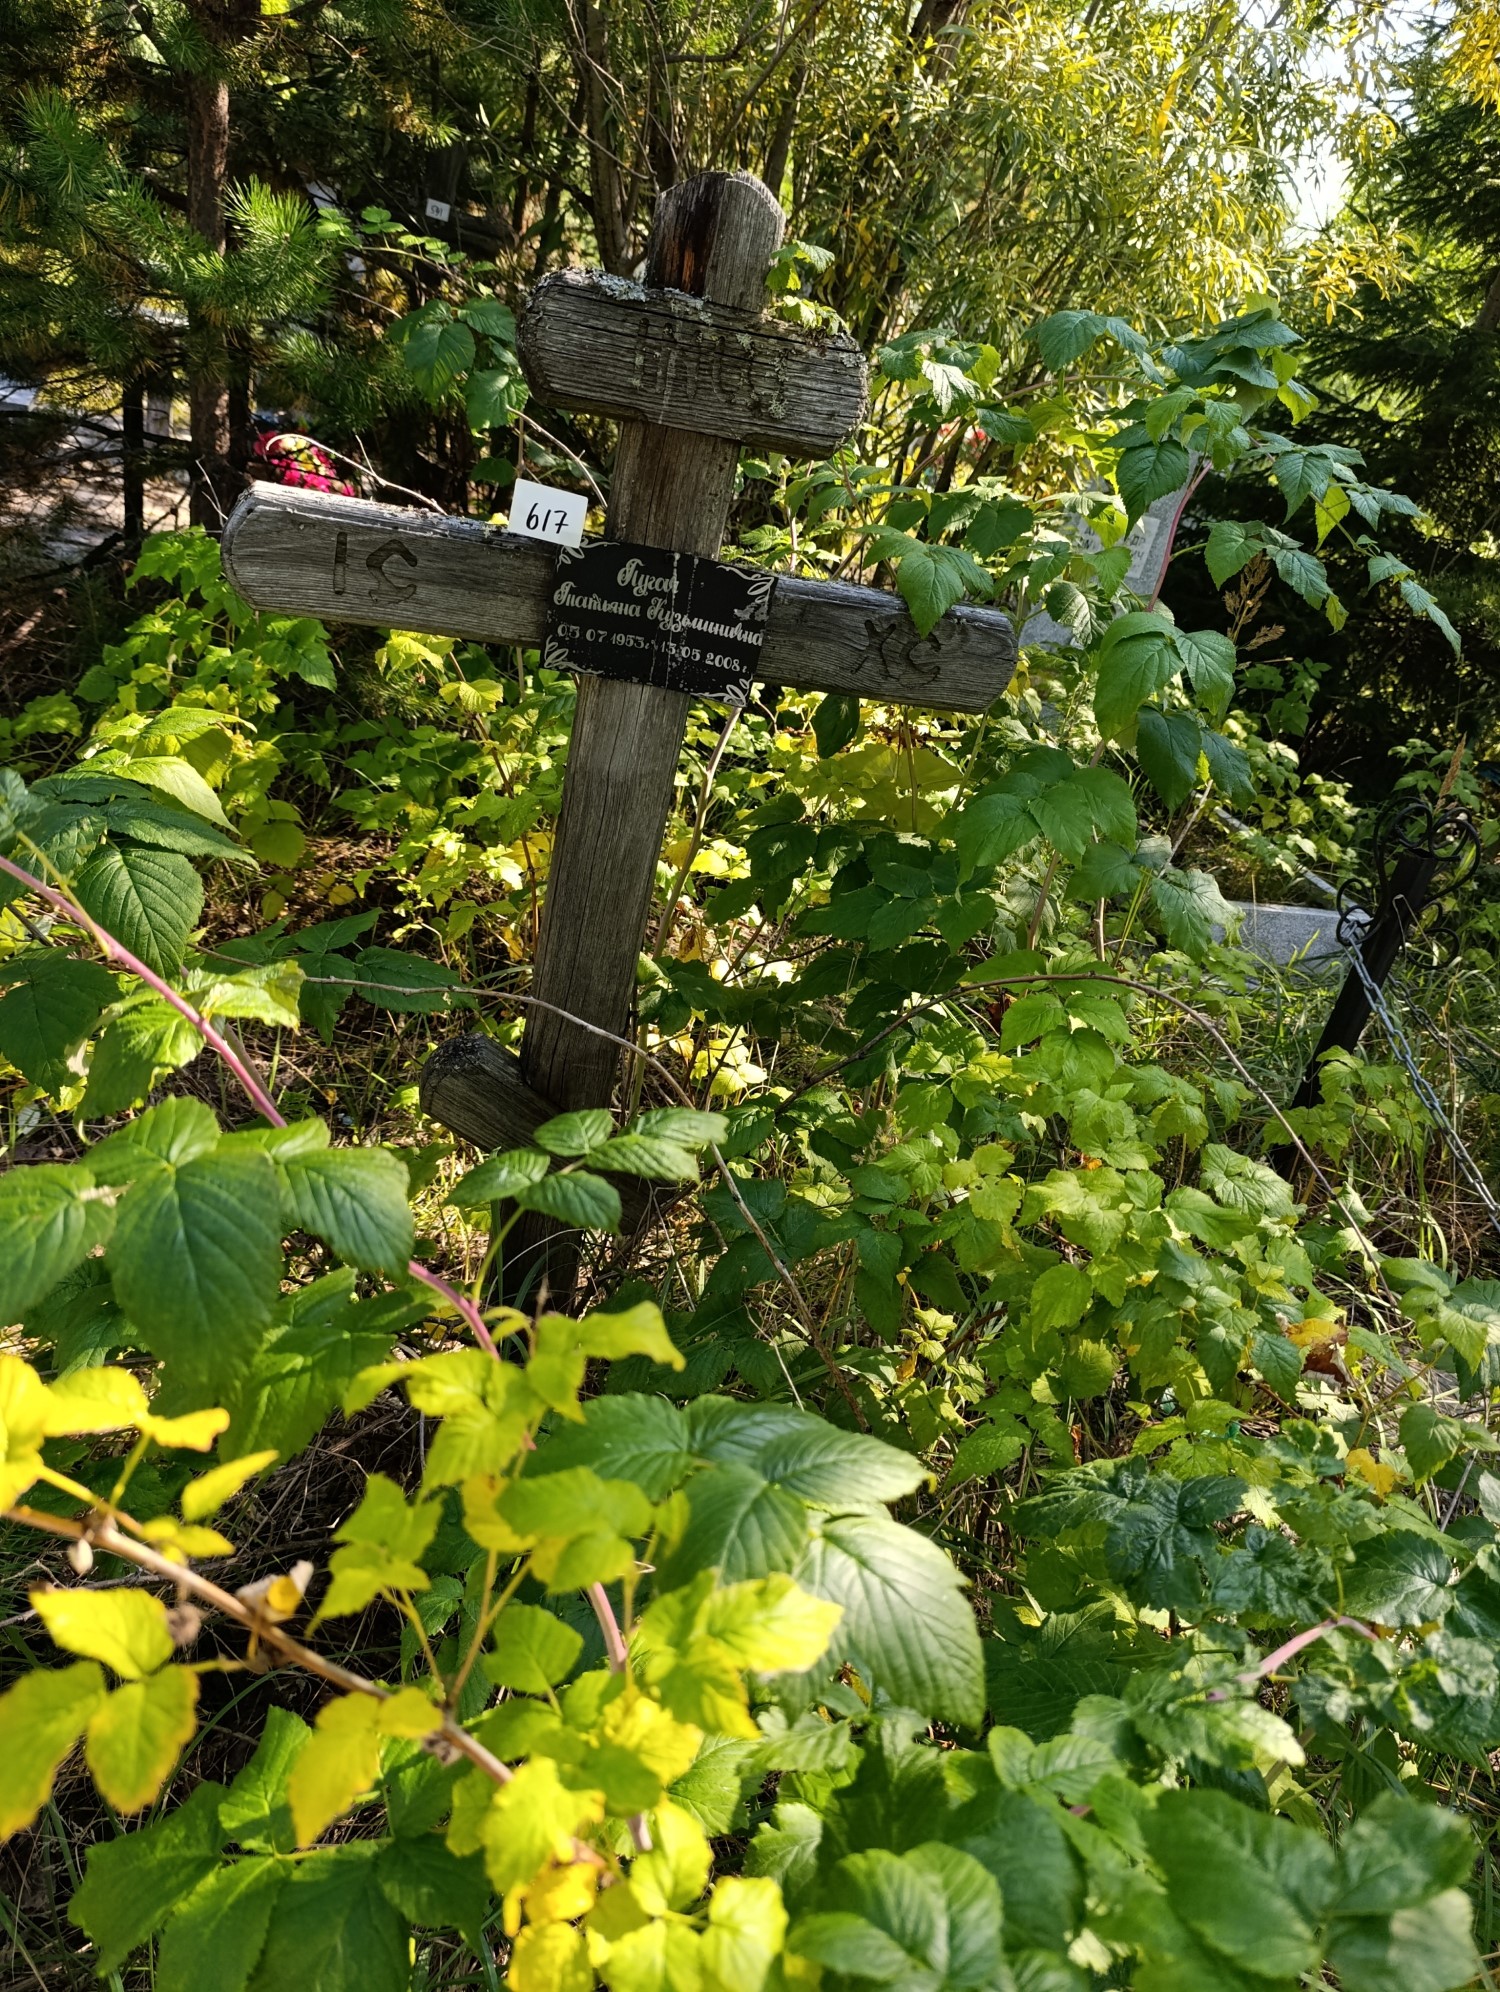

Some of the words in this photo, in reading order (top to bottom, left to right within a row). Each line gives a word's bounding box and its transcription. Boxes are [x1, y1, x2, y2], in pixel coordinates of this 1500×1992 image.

[526, 503, 569, 534] 617
[553, 581, 641, 618] Татьяна
[647, 597, 764, 646] Кузьминична
